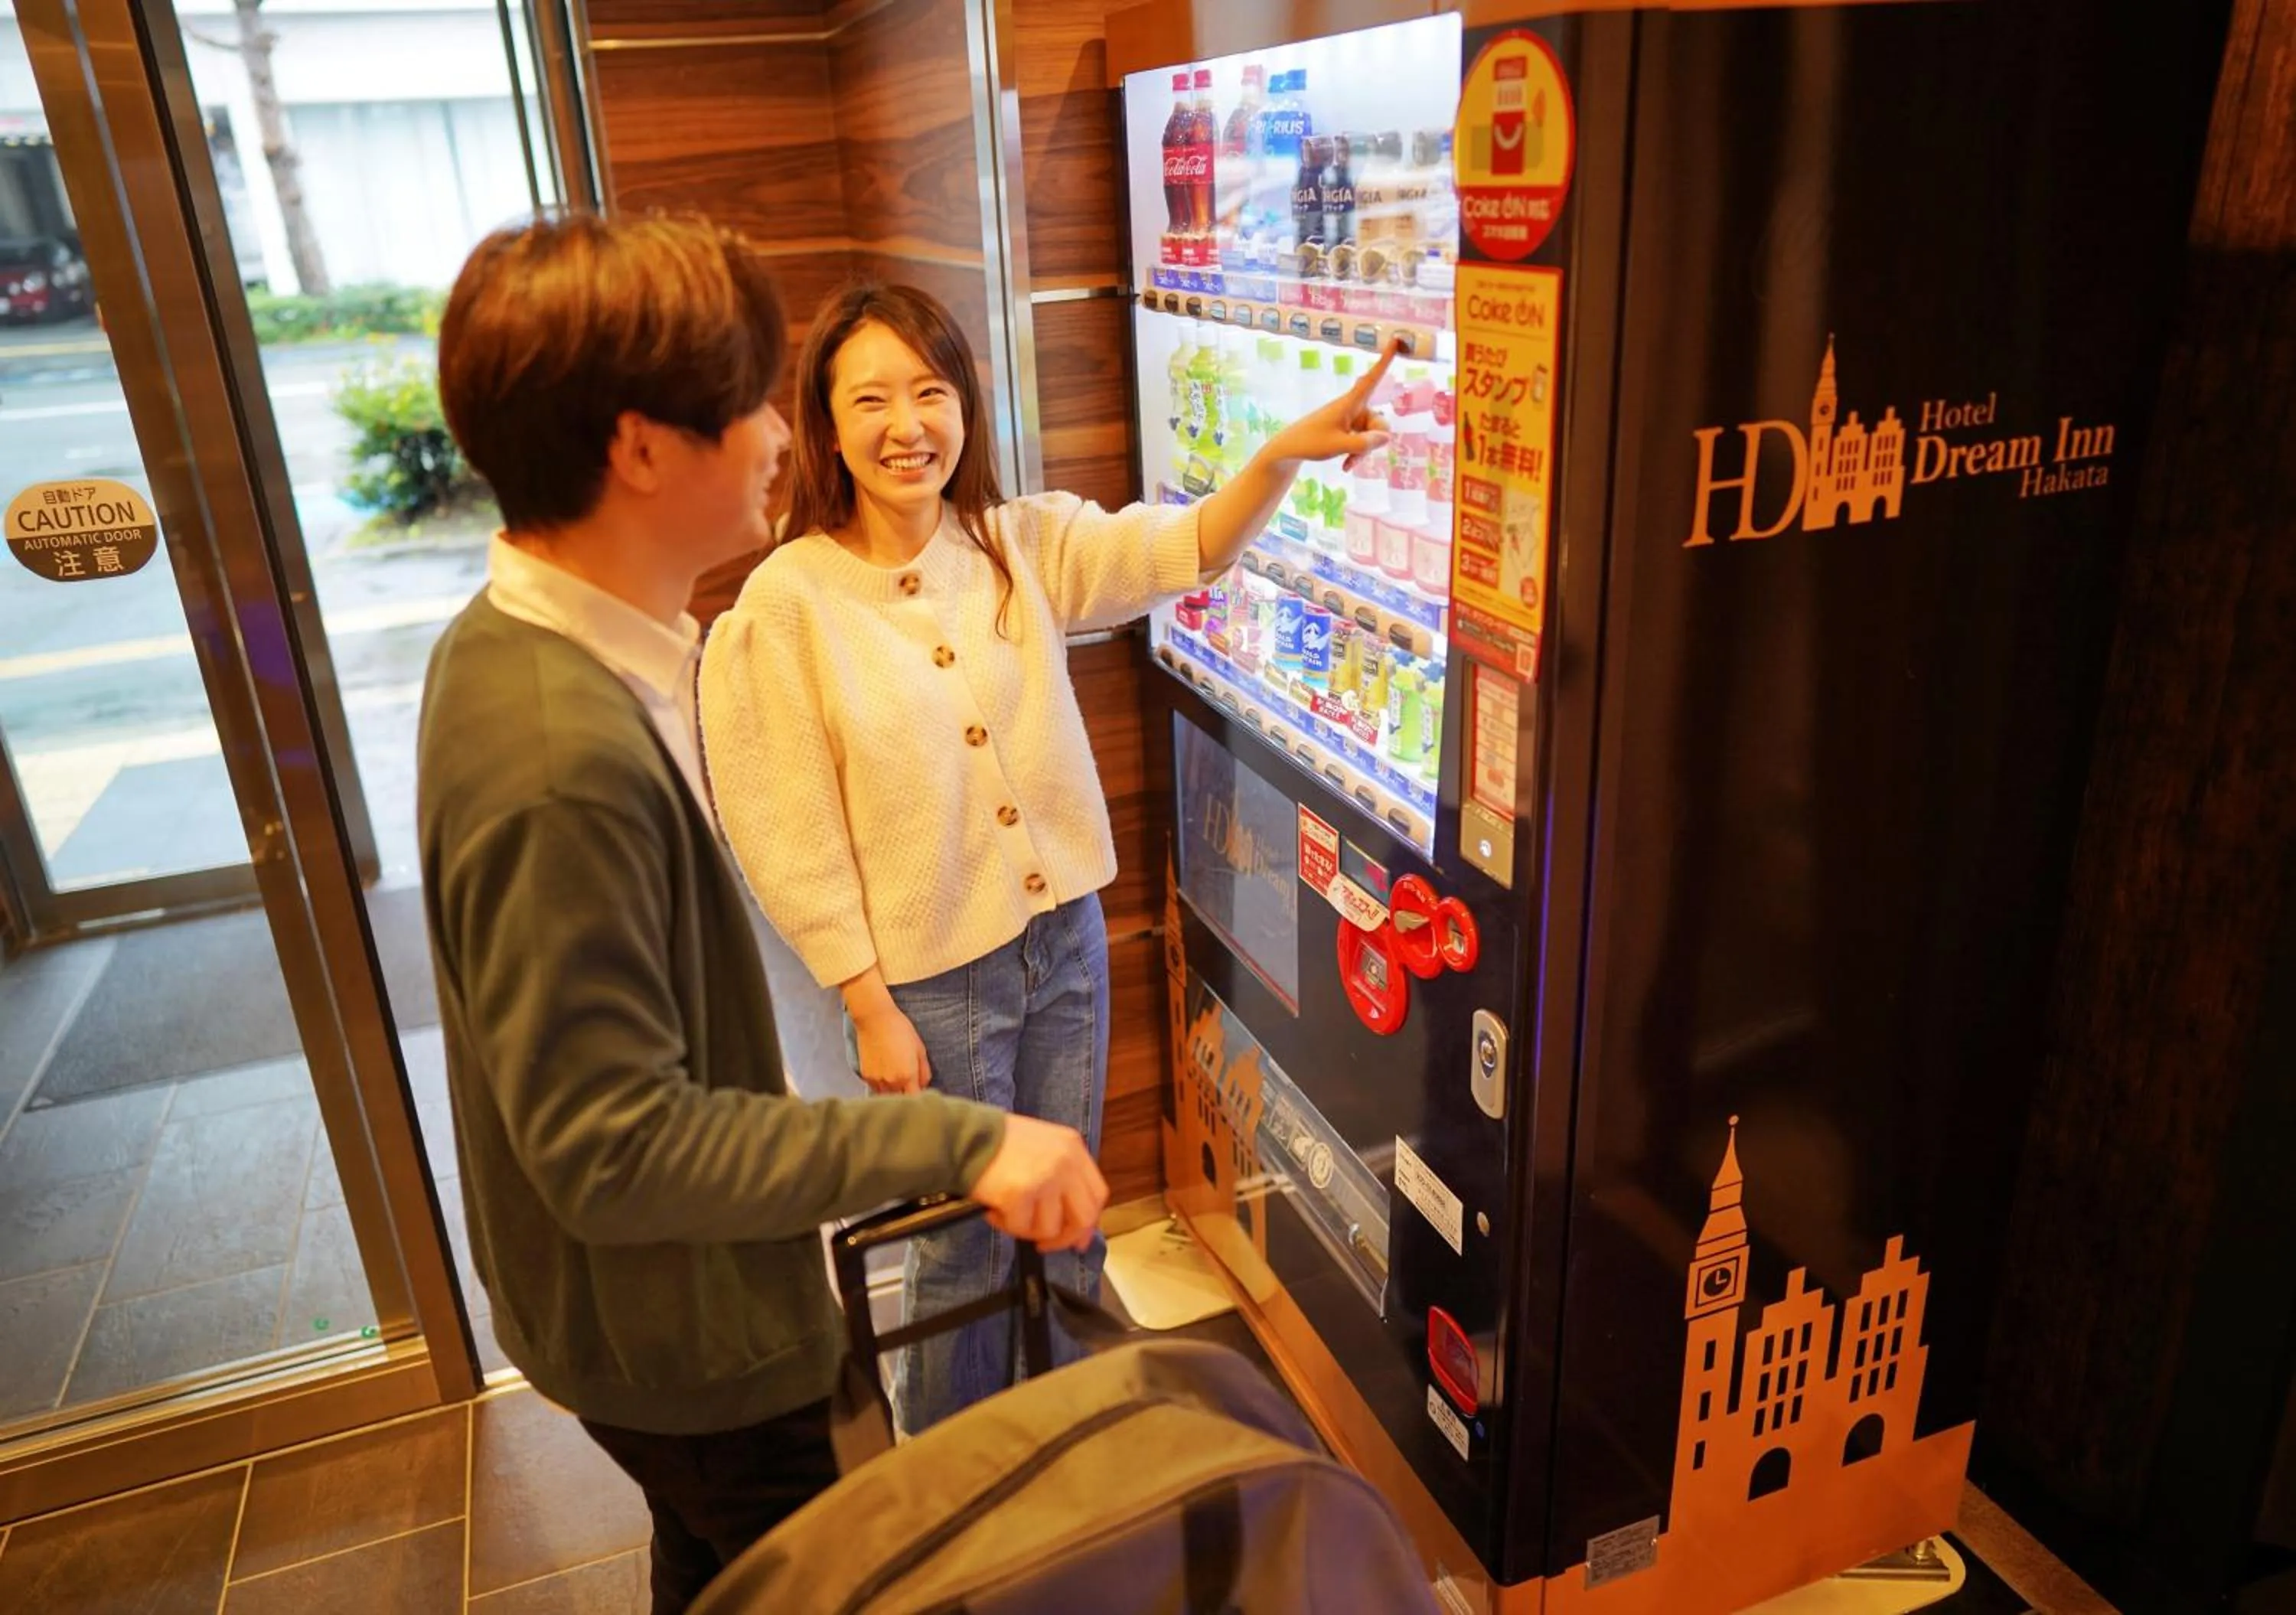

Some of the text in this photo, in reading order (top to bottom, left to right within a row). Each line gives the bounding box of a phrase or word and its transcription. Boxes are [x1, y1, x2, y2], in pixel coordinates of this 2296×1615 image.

[1467, 294, 1512, 325] Coke
[1463, 367, 1528, 405] スタンプ
[1919, 392, 1998, 432] Hotel
[1910, 417, 2115, 484] Dream Inn
[43, 487, 96, 504] 自動ドア
[1682, 419, 1810, 548] HD
[2019, 464, 2109, 498] Hakata
[18, 500, 136, 532] CAUTION
[24, 528, 142, 551] AUTOMATIC DOOR
[53, 545, 125, 577] 注意
